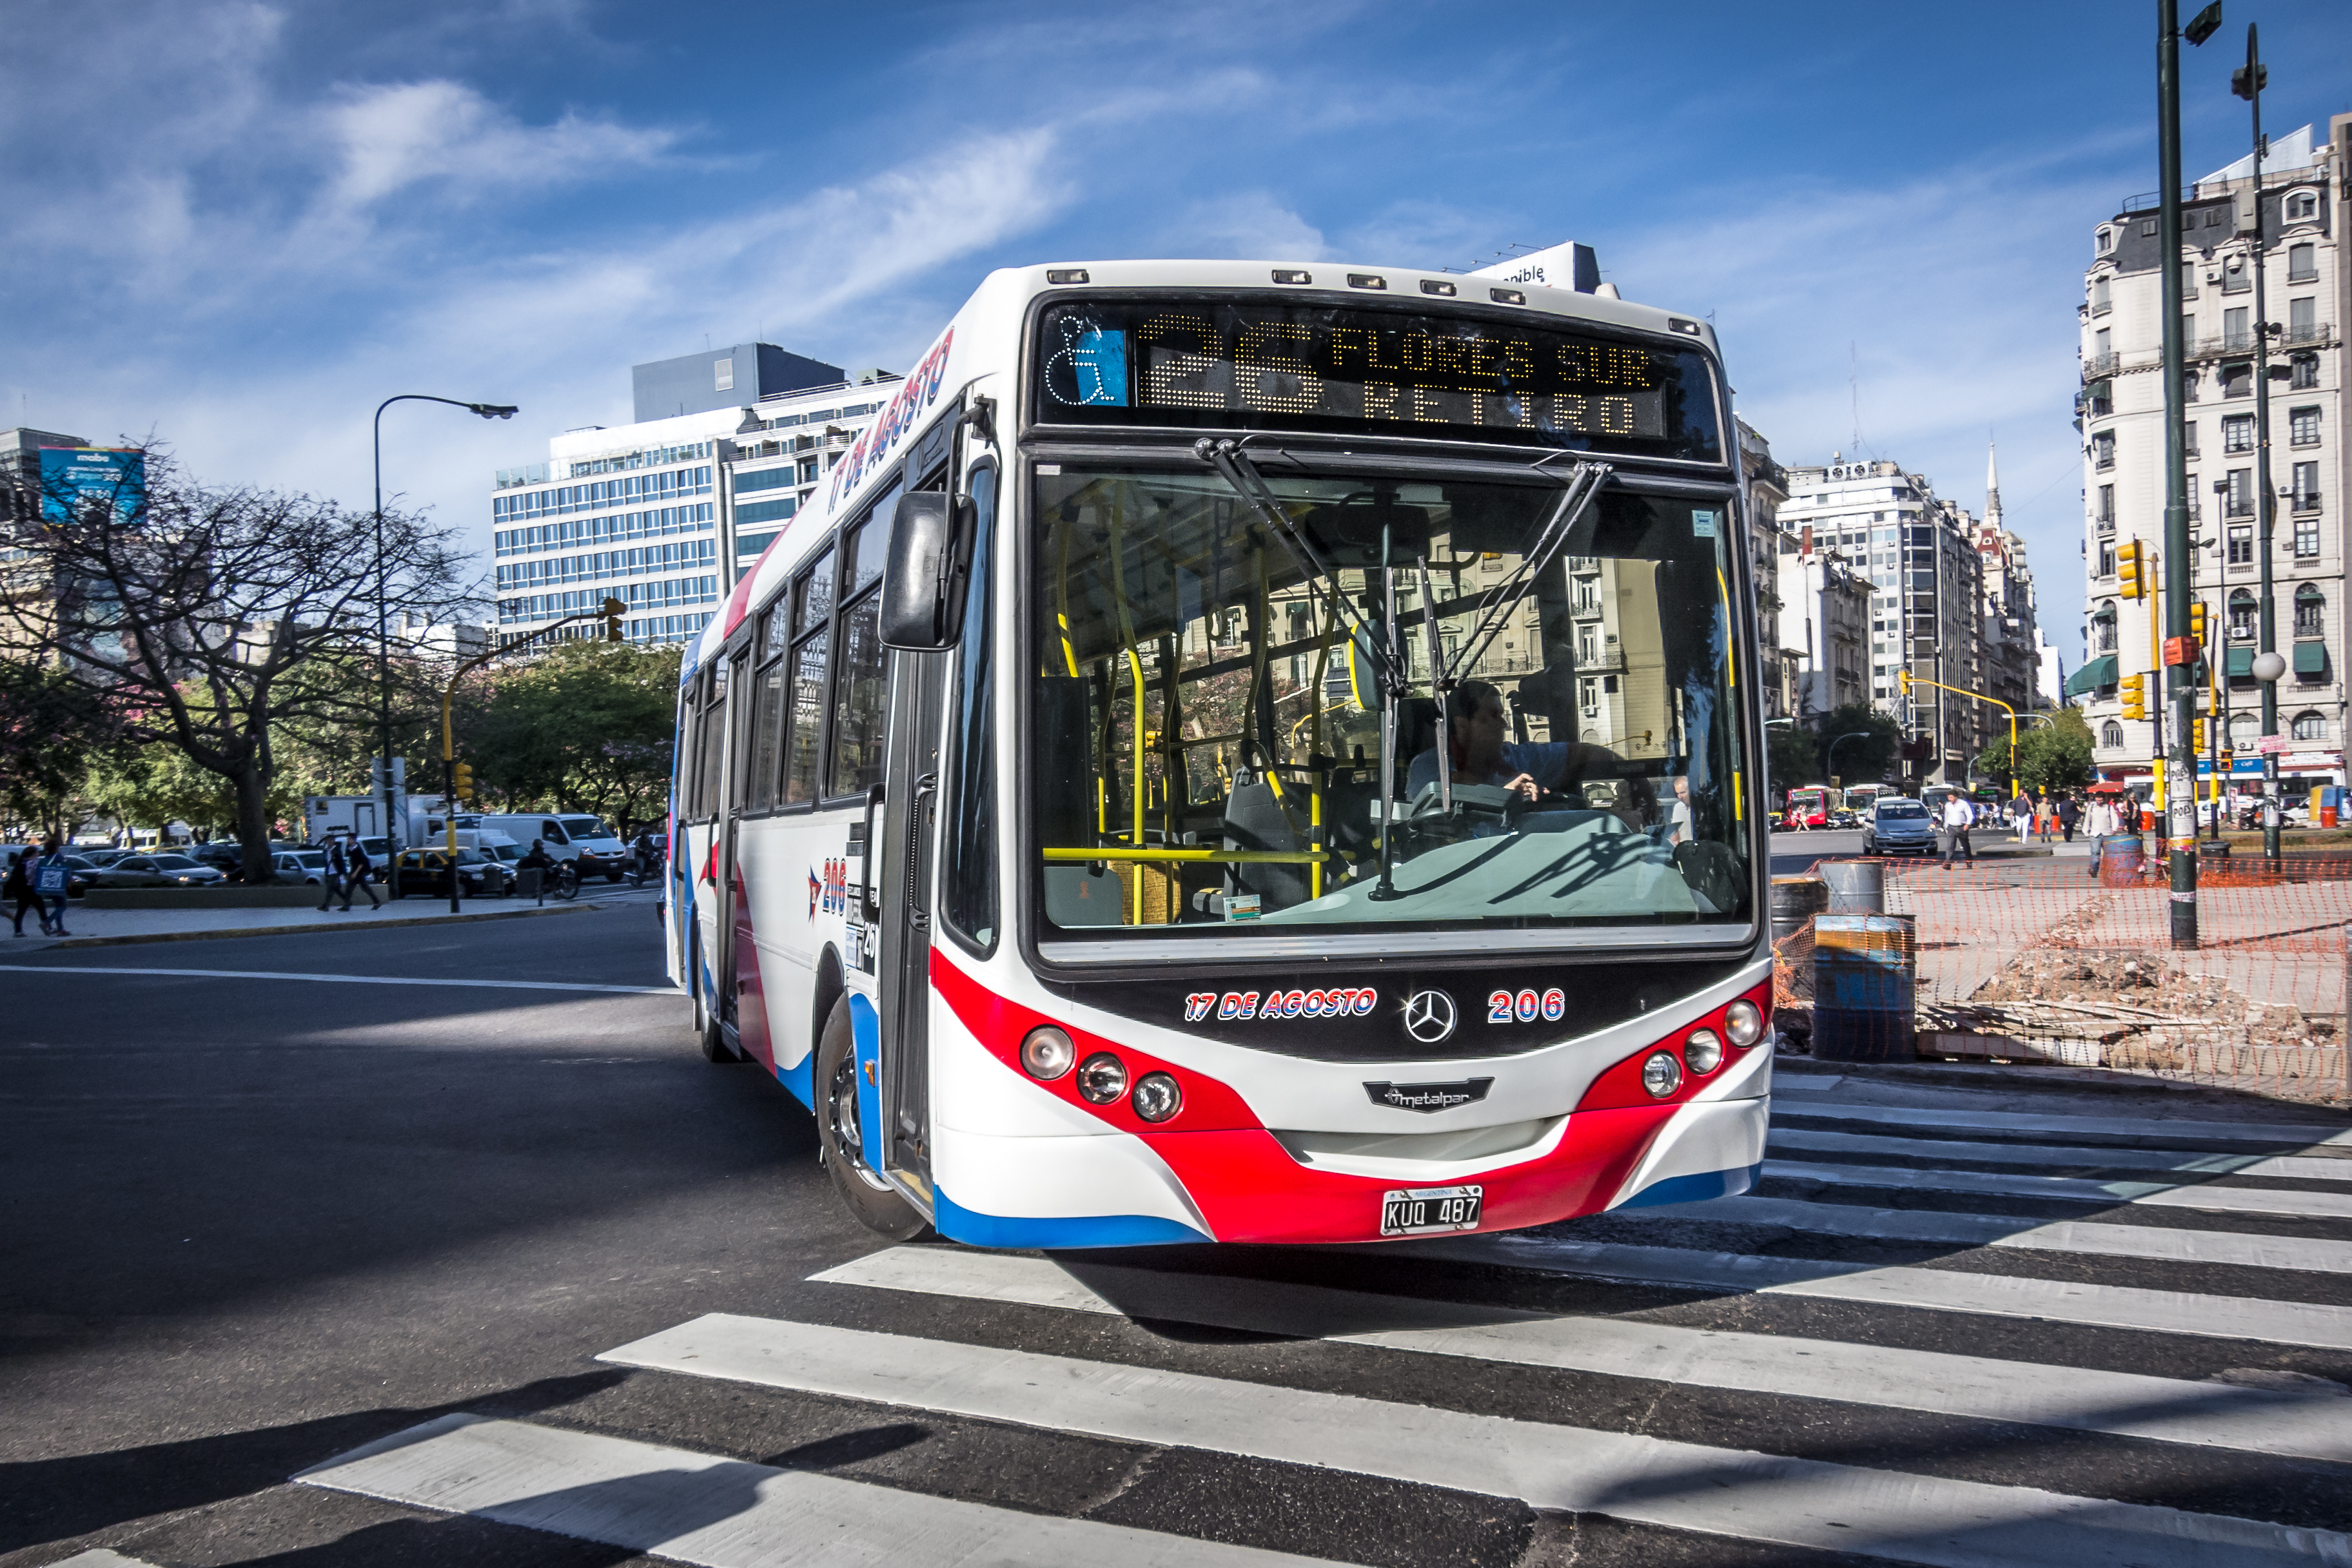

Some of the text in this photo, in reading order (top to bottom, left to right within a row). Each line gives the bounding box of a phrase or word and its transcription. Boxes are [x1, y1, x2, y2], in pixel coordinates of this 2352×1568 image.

[1139, 313, 1324, 413] 26
[1333, 328, 1651, 386] FLORES SUR
[828, 326, 954, 516] 17 DE AGOSTO
[1364, 380, 1634, 434] RETIRO
[822, 858, 847, 917] 206
[864, 921, 876, 958] 26
[1185, 987, 1377, 1021] 17 DE AGOSTO
[1487, 988, 1565, 1024] 206
[1393, 1092, 1469, 1108] metalpar
[1387, 1197, 1478, 1228] KUQ 487
